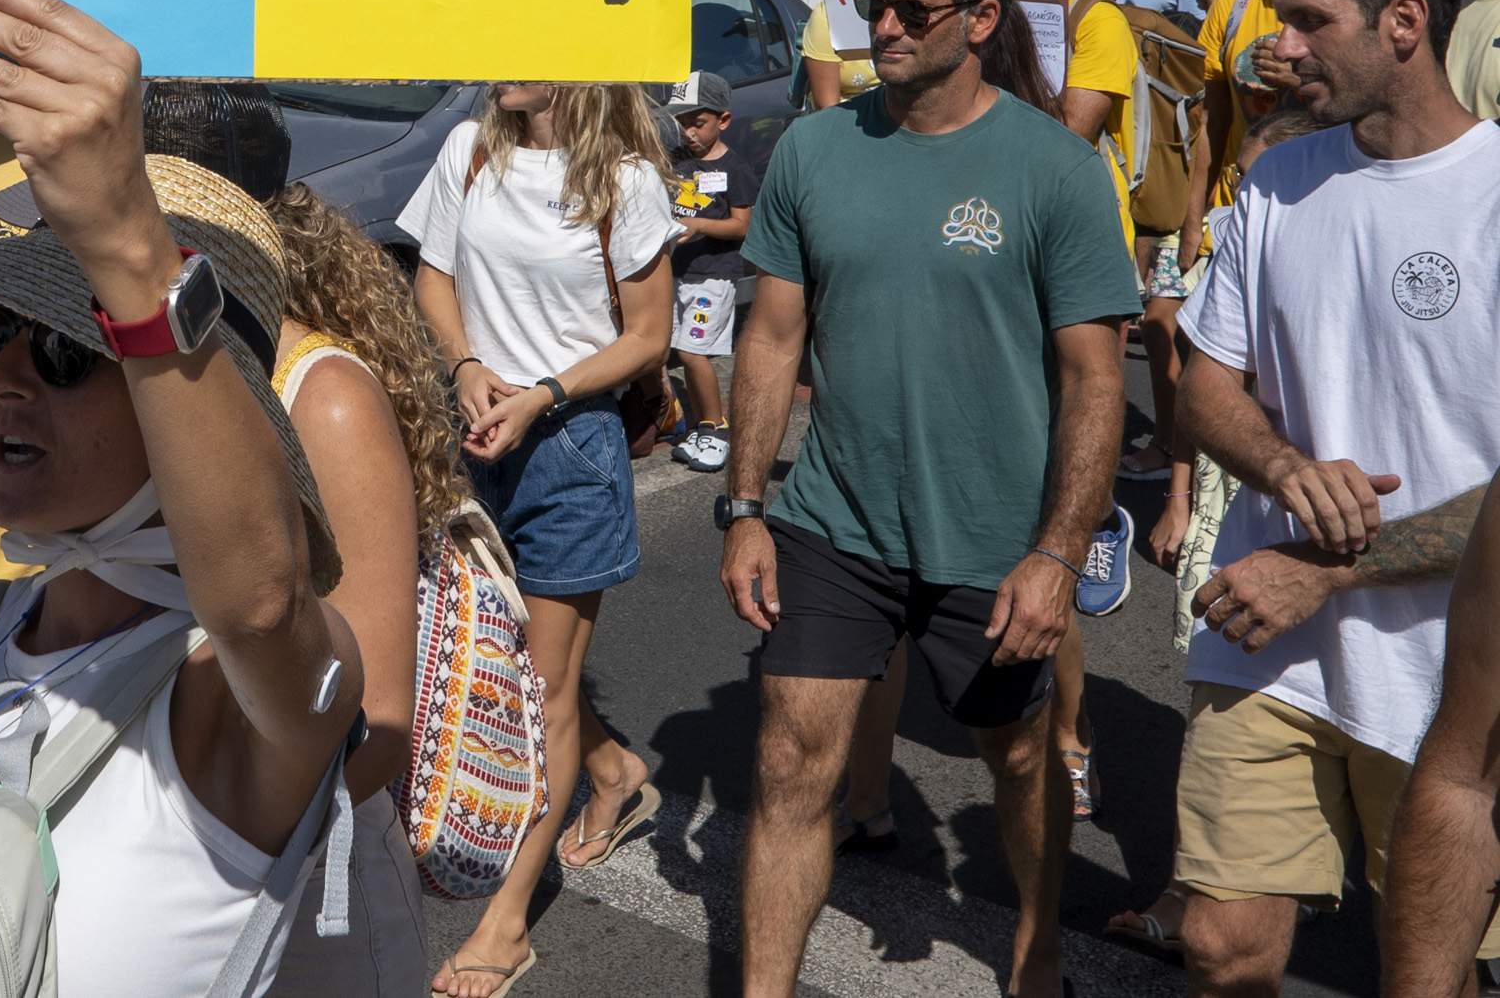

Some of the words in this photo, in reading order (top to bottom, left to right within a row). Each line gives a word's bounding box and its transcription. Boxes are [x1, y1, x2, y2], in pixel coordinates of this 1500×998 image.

[1400, 261, 1415, 275] LA
[1418, 256, 1456, 286] CALETA
[1401, 300, 1414, 312] JIU
[1415, 306, 1441, 316] JITSU
